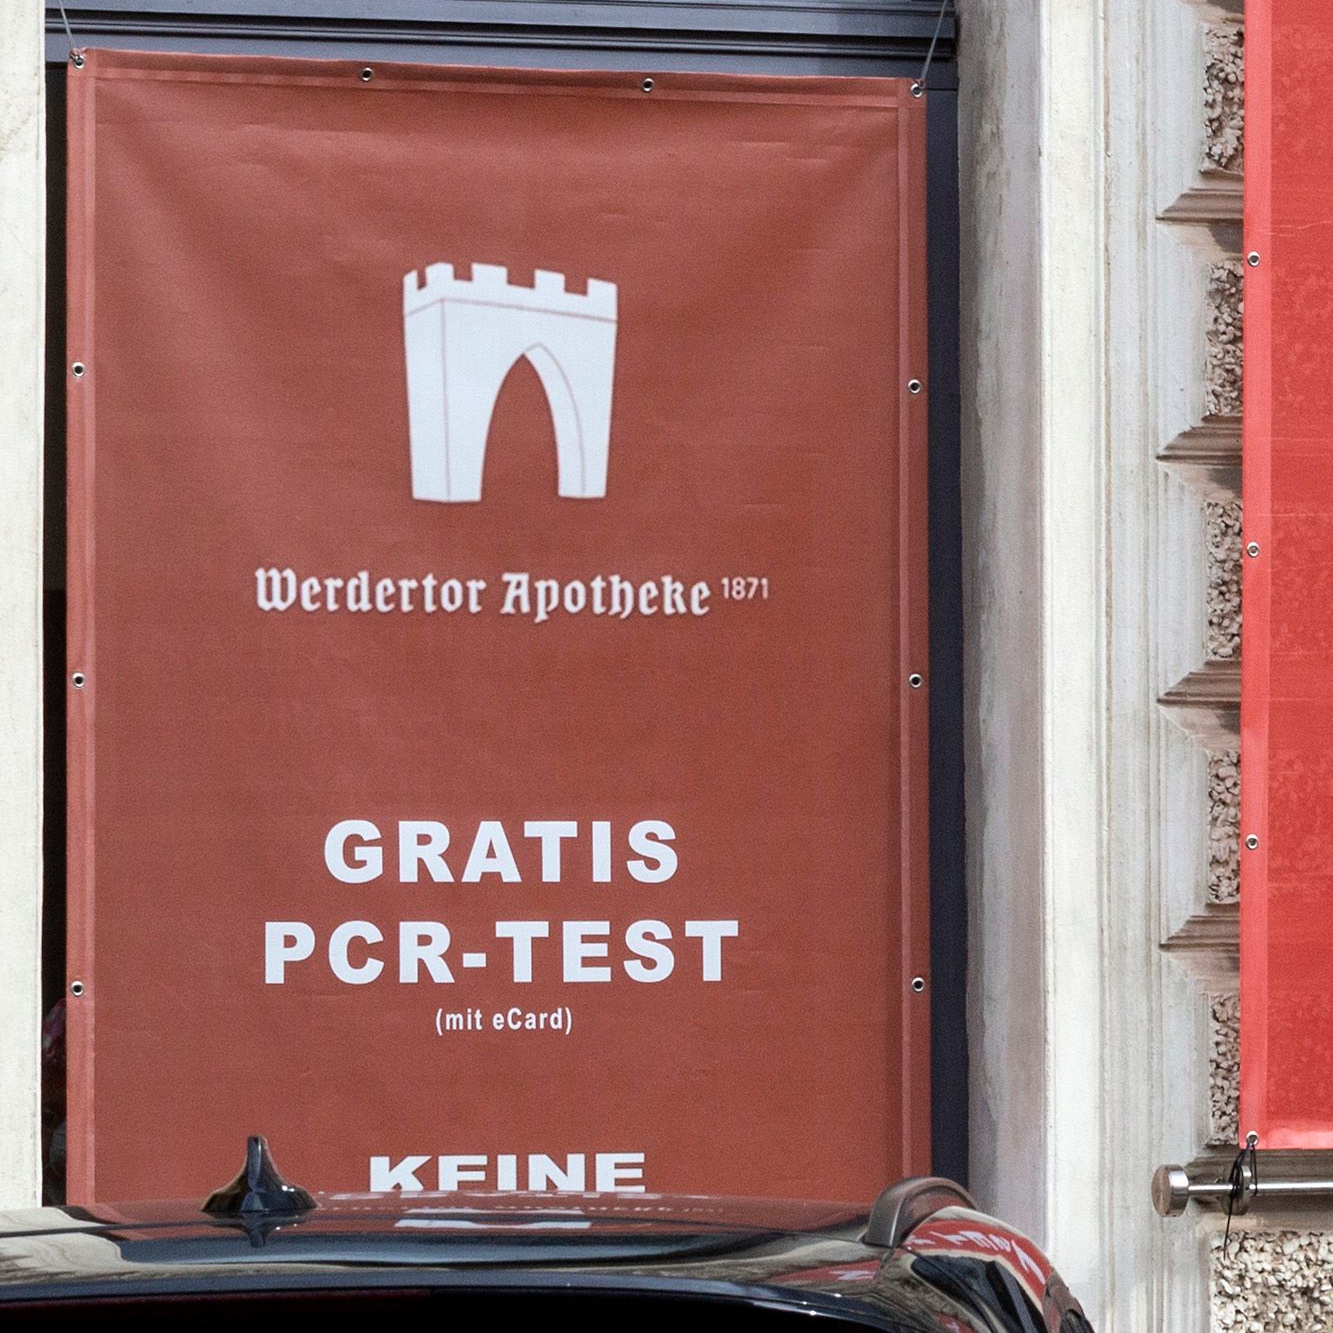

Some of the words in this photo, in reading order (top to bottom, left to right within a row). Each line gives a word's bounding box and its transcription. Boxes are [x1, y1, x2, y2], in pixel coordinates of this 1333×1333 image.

[254, 567, 487, 613] Werdertor
[500, 572, 711, 623] Apotheke
[722, 577, 768, 600] 1871
[324, 819, 678, 884] GRATIS
[264, 919, 739, 985] PCR-TEST
[435, 1006, 483, 1036] (mit
[492, 1005, 572, 1036] eCard)
